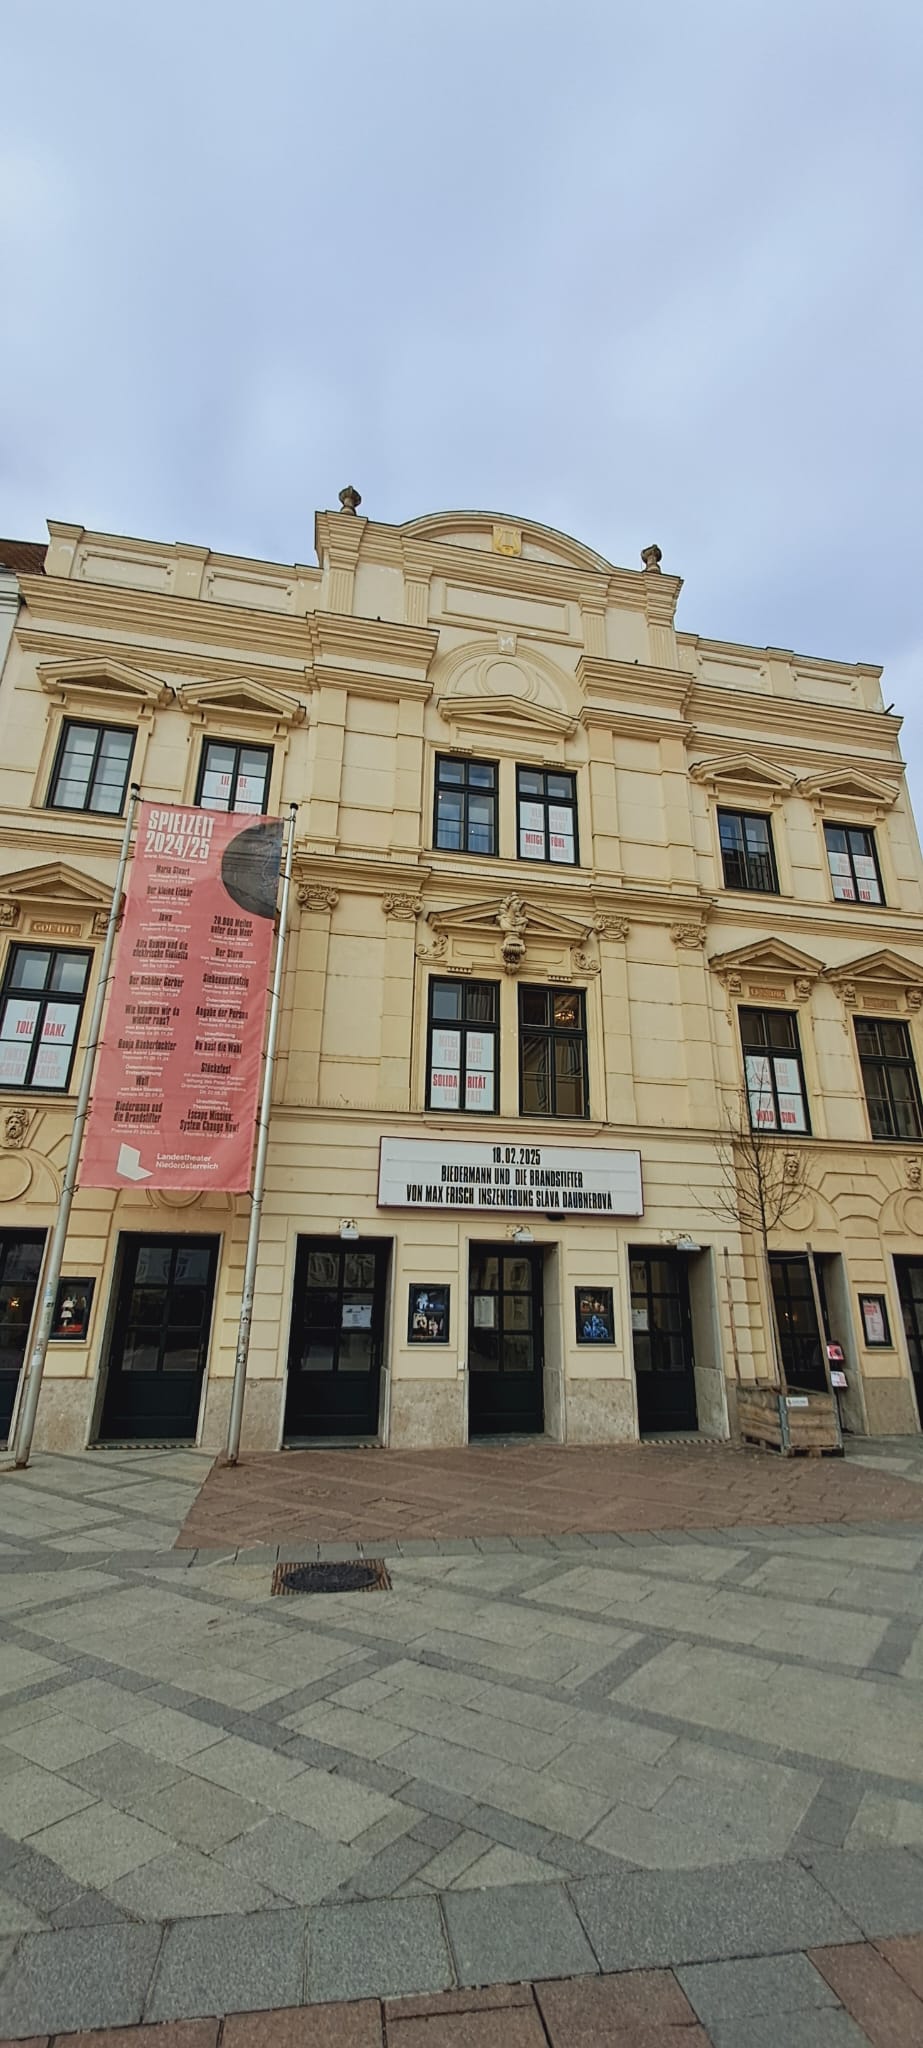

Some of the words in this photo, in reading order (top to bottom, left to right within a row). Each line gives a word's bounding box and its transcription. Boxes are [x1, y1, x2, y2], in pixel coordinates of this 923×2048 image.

[148, 810, 216, 838] SPIELZEIT
[144, 830, 210, 859] 2024/25
[525, 833, 543, 846] MITGE
[214, 916, 234, 926] 20.000
[235, 918, 252, 928] Meilen
[210, 926, 226, 934] unter
[227, 927, 238, 936] dem
[239, 928, 254, 937] Meer
[215, 947, 226, 957] Der
[227, 948, 244, 958] Sturm
[163, 977, 184, 988] Gerber
[161, 1006, 172, 1016] wir
[172, 1006, 180, 1016] da
[196, 1006, 216, 1018] Angabe
[218, 1008, 228, 1018] der
[16, 1020, 34, 1034] TOLE
[44, 1022, 67, 1037] RANZ
[194, 1040, 202, 1050] Du
[218, 1042, 226, 1052] die
[228, 1042, 242, 1054] Wahl
[432, 1074, 458, 1088] SOLIDA
[467, 1074, 486, 1090] RITÄT
[115, 1100, 151, 1112] Biedermann
[152, 1102, 163, 1112] und
[114, 1112, 124, 1122] die
[124, 1112, 162, 1124] Brandstifter
[188, 1109, 208, 1121] Escape
[180, 1119, 201, 1131] System
[202, 1120, 224, 1133] Change
[157, 1153, 212, 1162] Landestheater
[492, 1147, 541, 1166] 18.02.2025
[156, 1162, 218, 1170] Niederösterreich
[441, 1165, 492, 1184] BIEDERMANN
[494, 1168, 510, 1186] UND
[515, 1168, 528, 1186] DIE
[529, 1169, 584, 1188] BRANDSTIFTER
[406, 1184, 423, 1202] VON
[425, 1185, 444, 1204] MAX
[446, 1186, 474, 1205] FRISCH
[478, 1188, 534, 1207] INSZENIERUNG
[536, 1188, 560, 1208] SLÁVA
[562, 1190, 612, 1210] DAUBNEROVÁ
